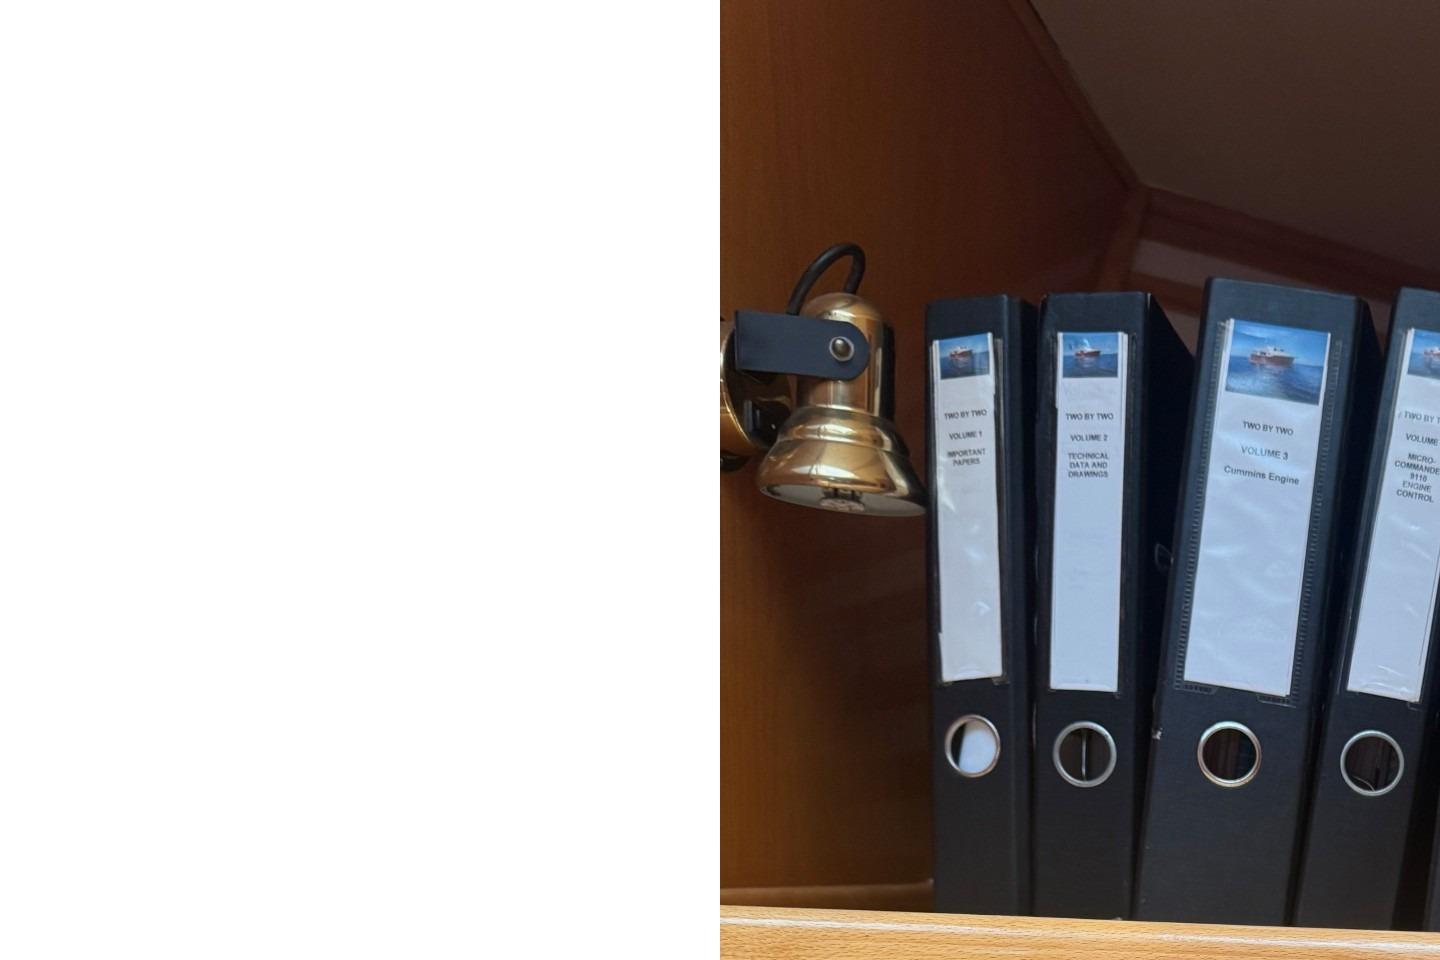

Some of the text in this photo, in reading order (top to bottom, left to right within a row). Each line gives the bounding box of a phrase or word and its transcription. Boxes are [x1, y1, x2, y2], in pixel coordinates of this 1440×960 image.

[1404, 410, 1422, 421] TWO
[1423, 414, 1435, 423] BY
[1243, 420, 1294, 436] TWO BY TWO
[949, 430, 977, 440] VOLUME
[1405, 433, 1438, 447] VOLUME
[947, 448, 986, 458] IMPORTANT
[1068, 452, 1109, 460] TECHNICAL
[1241, 445, 1289, 461] VOLUME 3
[952, 458, 981, 466] PAPERS
[1070, 461, 1108, 469] DATA AND
[1068, 470, 1109, 478] DRAWINGS
[1223, 465, 1300, 485] Cummins Engine
[1402, 480, 1432, 493] ENGINE
[1396, 488, 1434, 503] CONTROL
